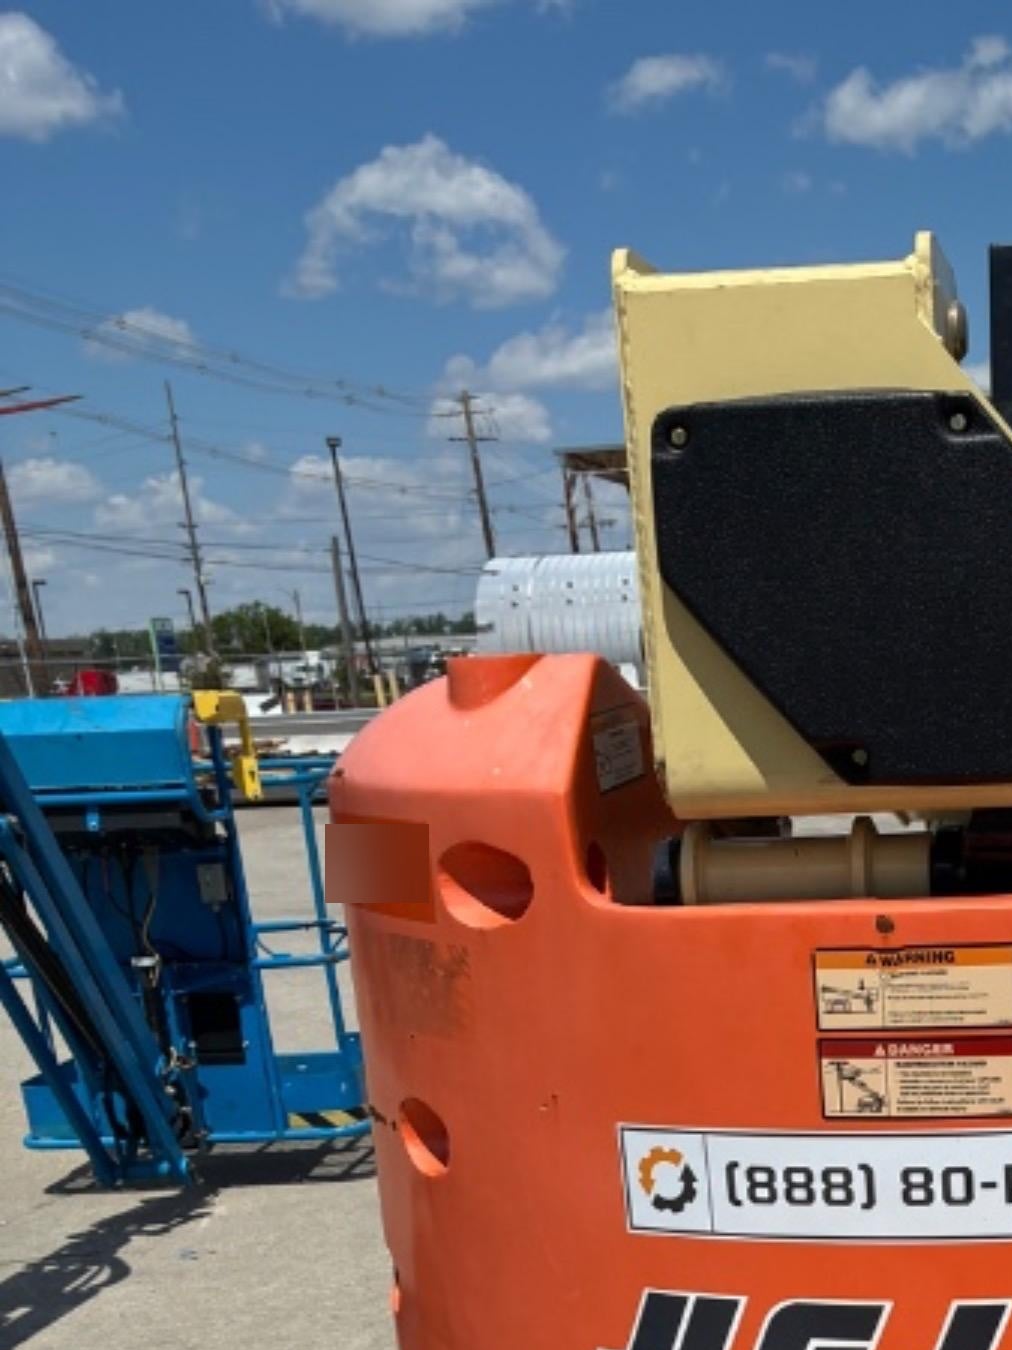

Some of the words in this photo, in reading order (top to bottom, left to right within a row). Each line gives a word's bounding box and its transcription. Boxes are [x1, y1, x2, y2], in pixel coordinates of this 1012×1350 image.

[881, 951, 955, 967] WARNING
[887, 1043, 954, 1057] DANGER
[724, 1161, 876, 1210] (888)
